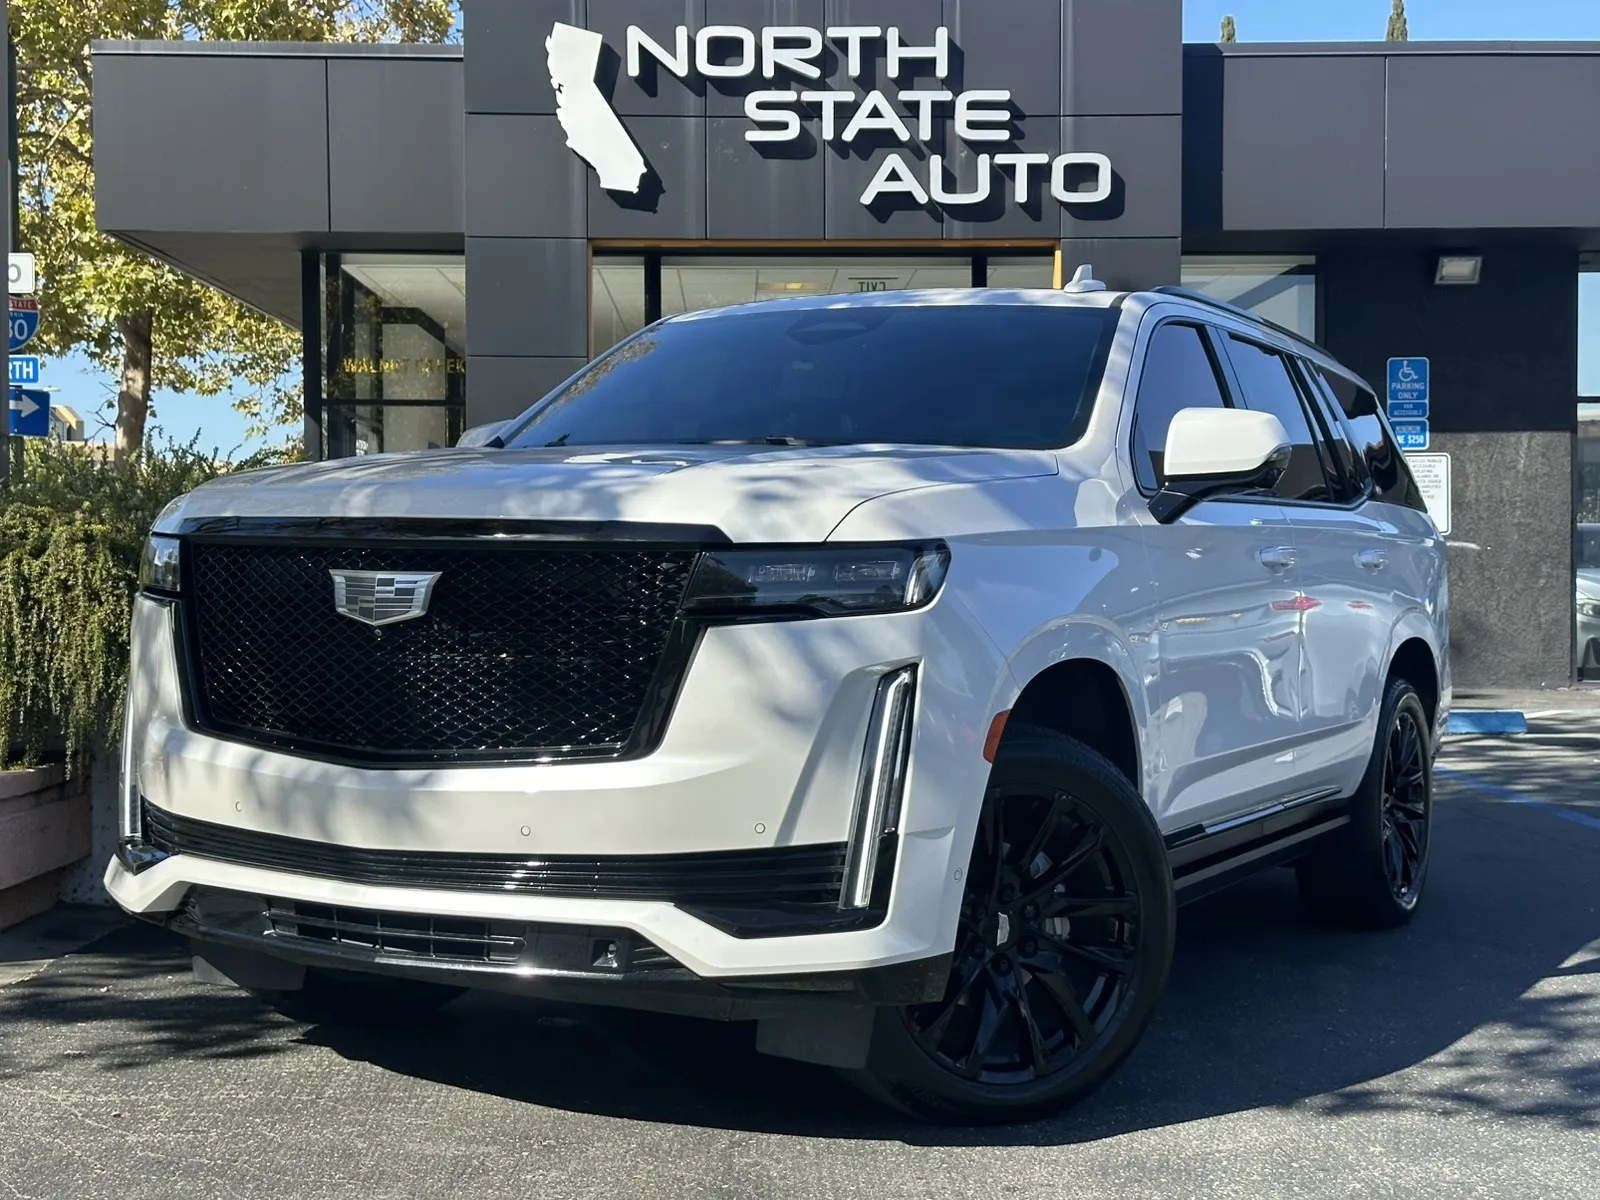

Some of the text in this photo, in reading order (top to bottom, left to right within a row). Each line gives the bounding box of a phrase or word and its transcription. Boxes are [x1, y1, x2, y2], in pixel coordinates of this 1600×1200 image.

[626, 25, 949, 79] NORTH
[744, 89, 1011, 142] STATE
[859, 152, 1112, 206] AUTO
[1391, 382, 1425, 390] PARKING
[1407, 434, 1424, 444] $250
